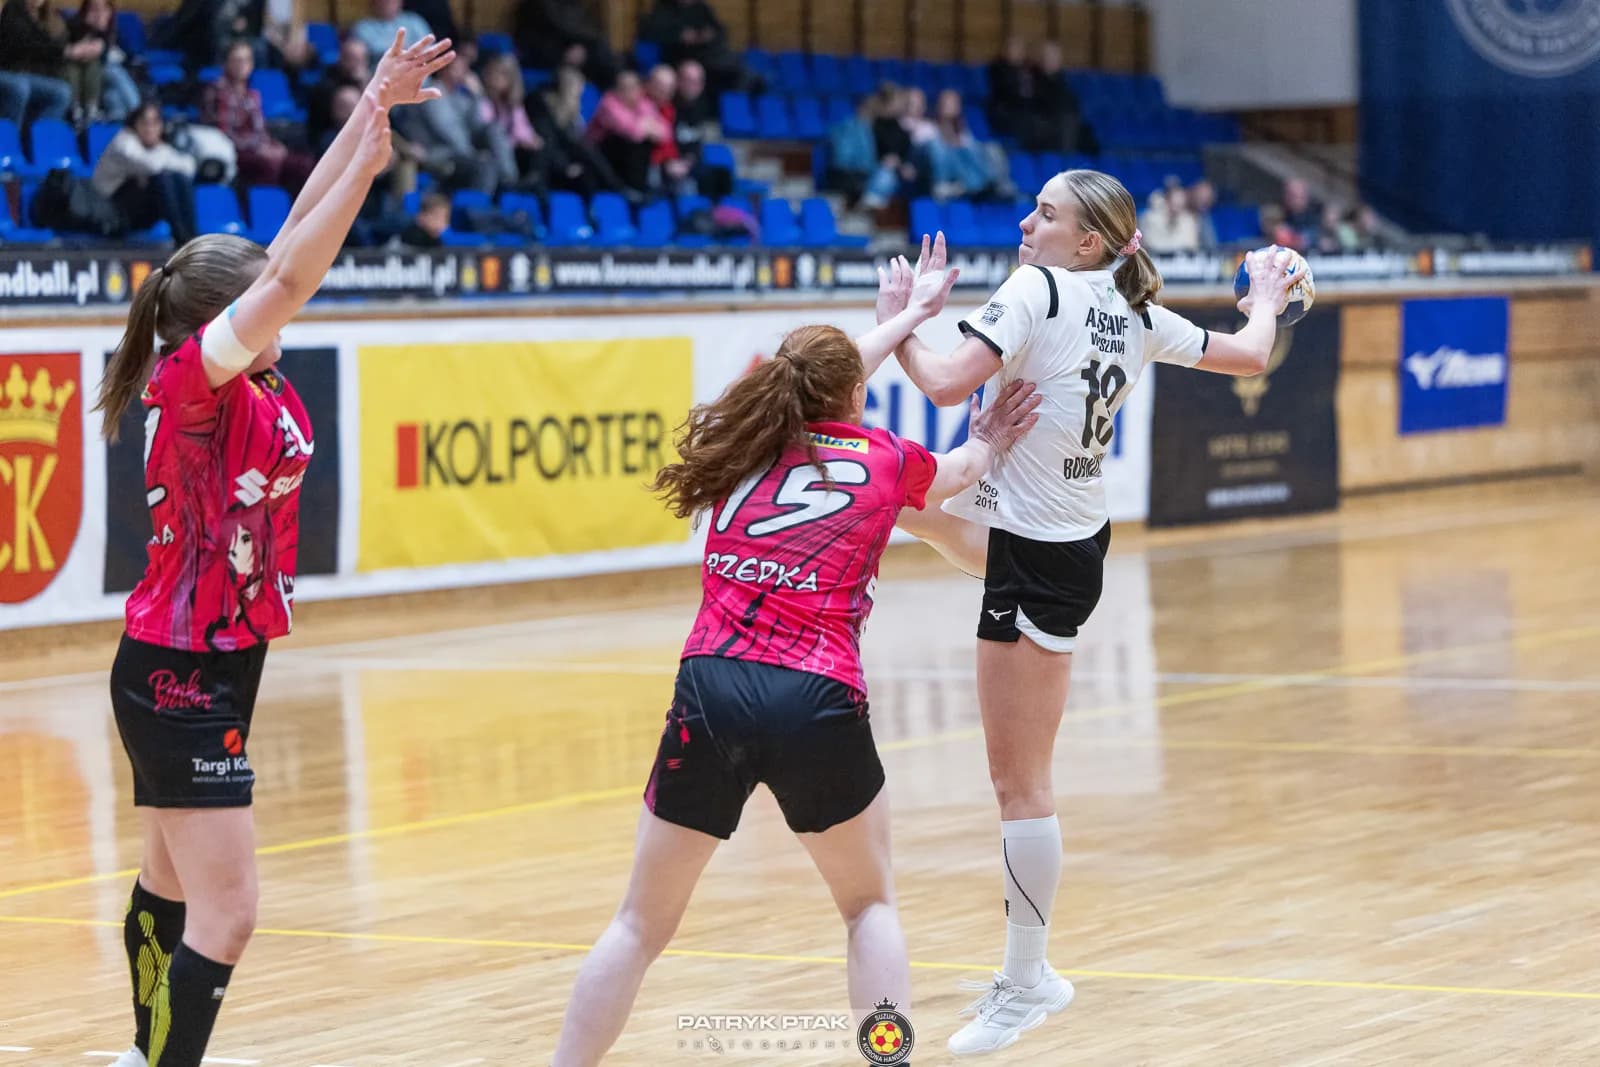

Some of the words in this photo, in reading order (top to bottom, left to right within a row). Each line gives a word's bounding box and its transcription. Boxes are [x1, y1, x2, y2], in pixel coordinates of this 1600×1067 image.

[423, 411, 665, 487] KOLPORTER
[716, 459, 870, 538] 15
[975, 495, 998, 511] 2011
[192, 758, 231, 775] Targi
